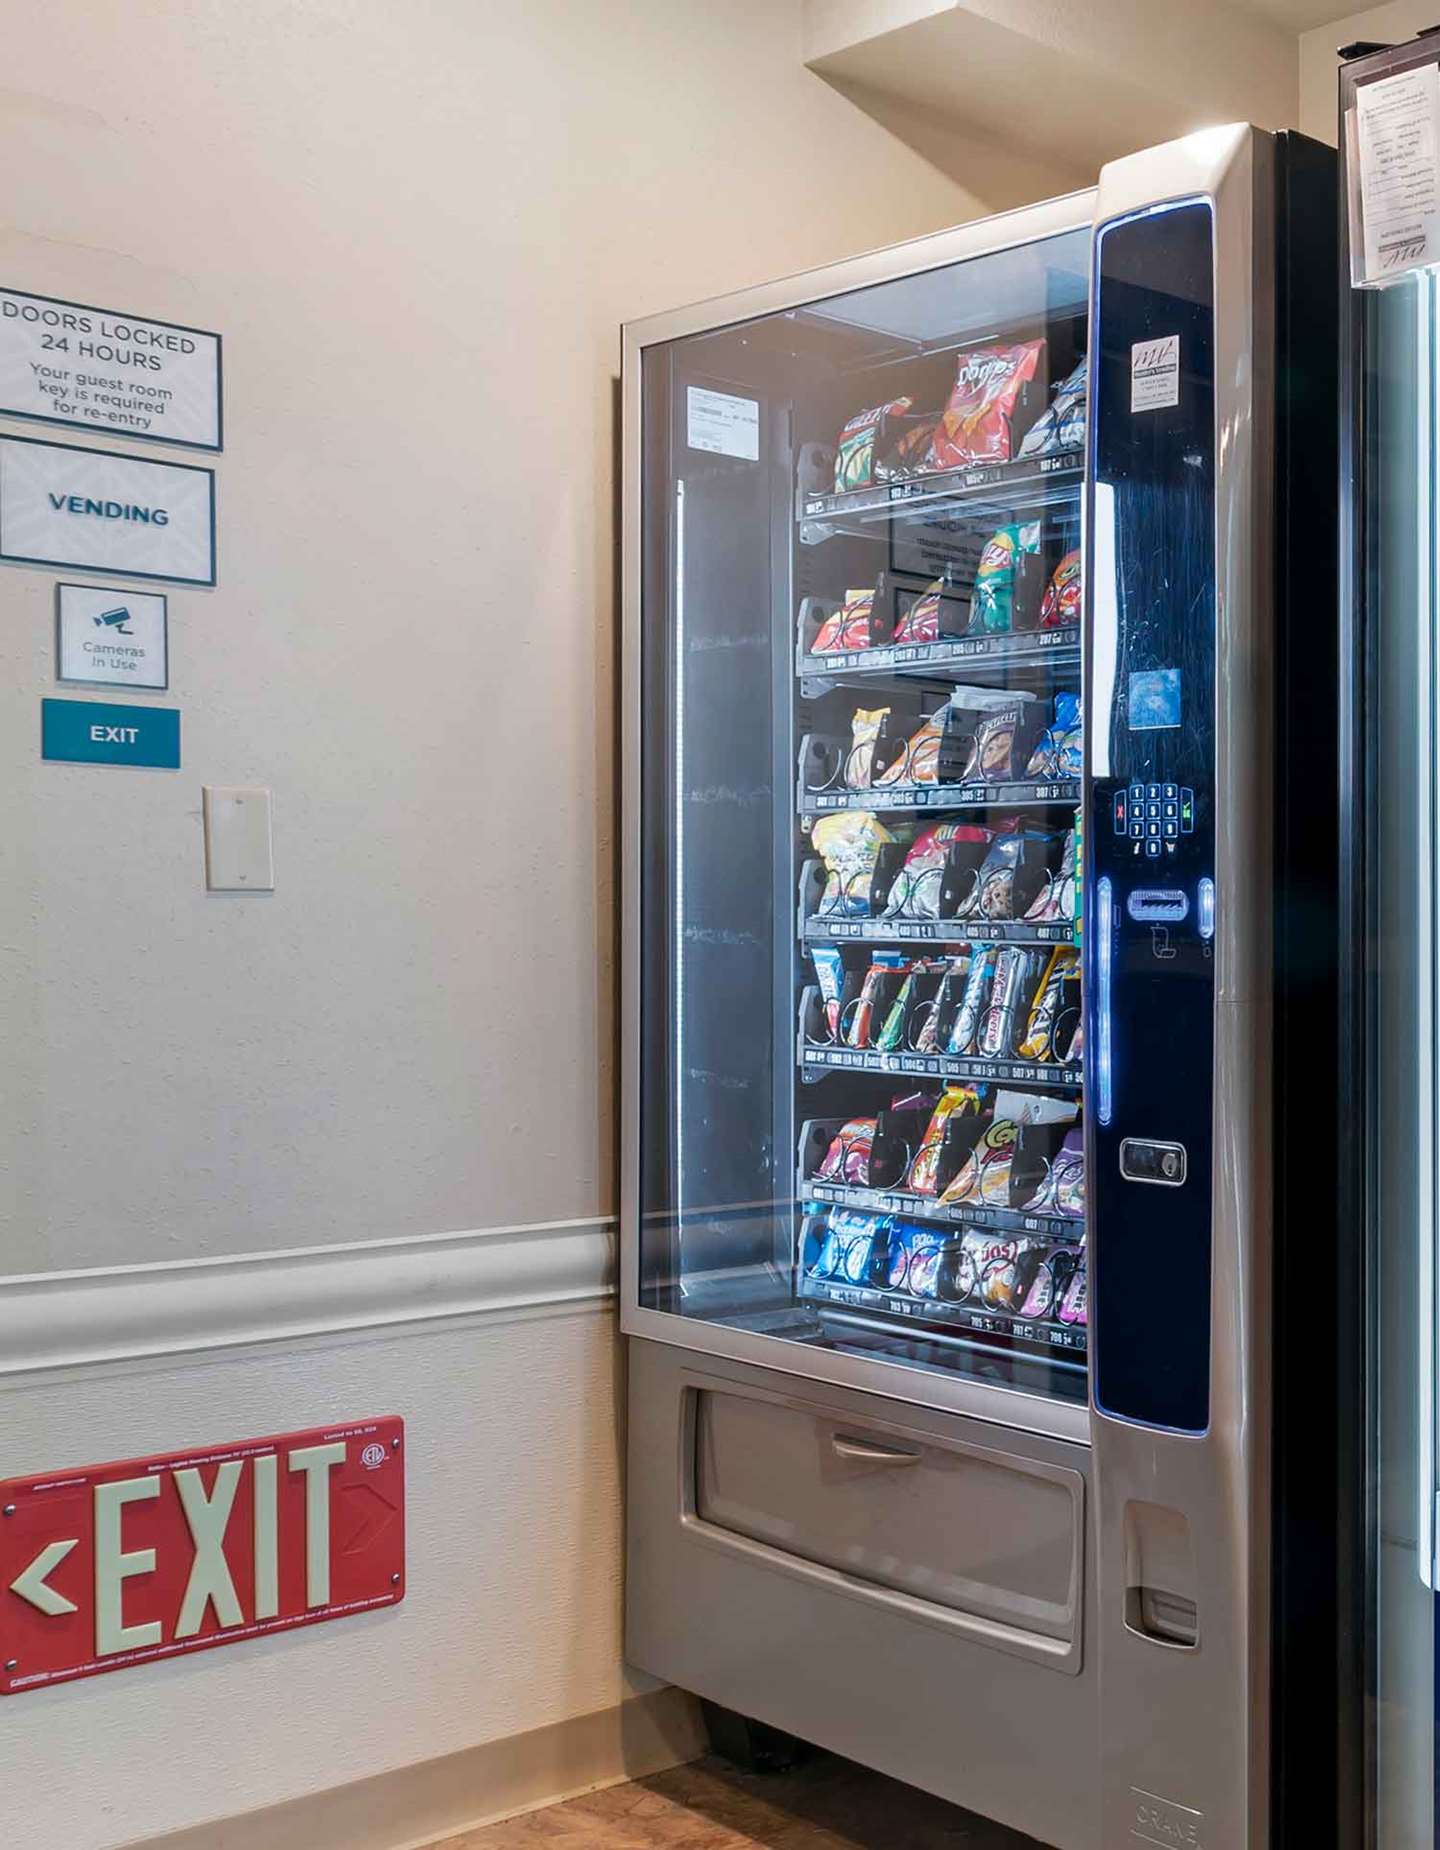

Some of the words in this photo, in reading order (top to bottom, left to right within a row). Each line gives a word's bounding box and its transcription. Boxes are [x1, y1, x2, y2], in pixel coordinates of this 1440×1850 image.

[2, 301, 92, 333] DOORS
[100, 321, 195, 354] LOCKED
[41, 334, 70, 353] 24
[78, 341, 162, 371] HOURS
[30, 362, 70, 381] Your
[77, 372, 123, 391] guest
[129, 383, 173, 400] room
[38, 380, 68, 399] key
[75, 387, 88, 401] is
[94, 391, 165, 416] required
[53, 399, 77, 415] for
[84, 407, 152, 429] re-entry
[48, 493, 169, 526] VENDING
[83, 641, 146, 658] Cameras
[92, 656, 105, 669] In
[110, 658, 137, 672] Use
[90, 725, 139, 743] EXIT
[94, 1442, 346, 1657] EXIT
